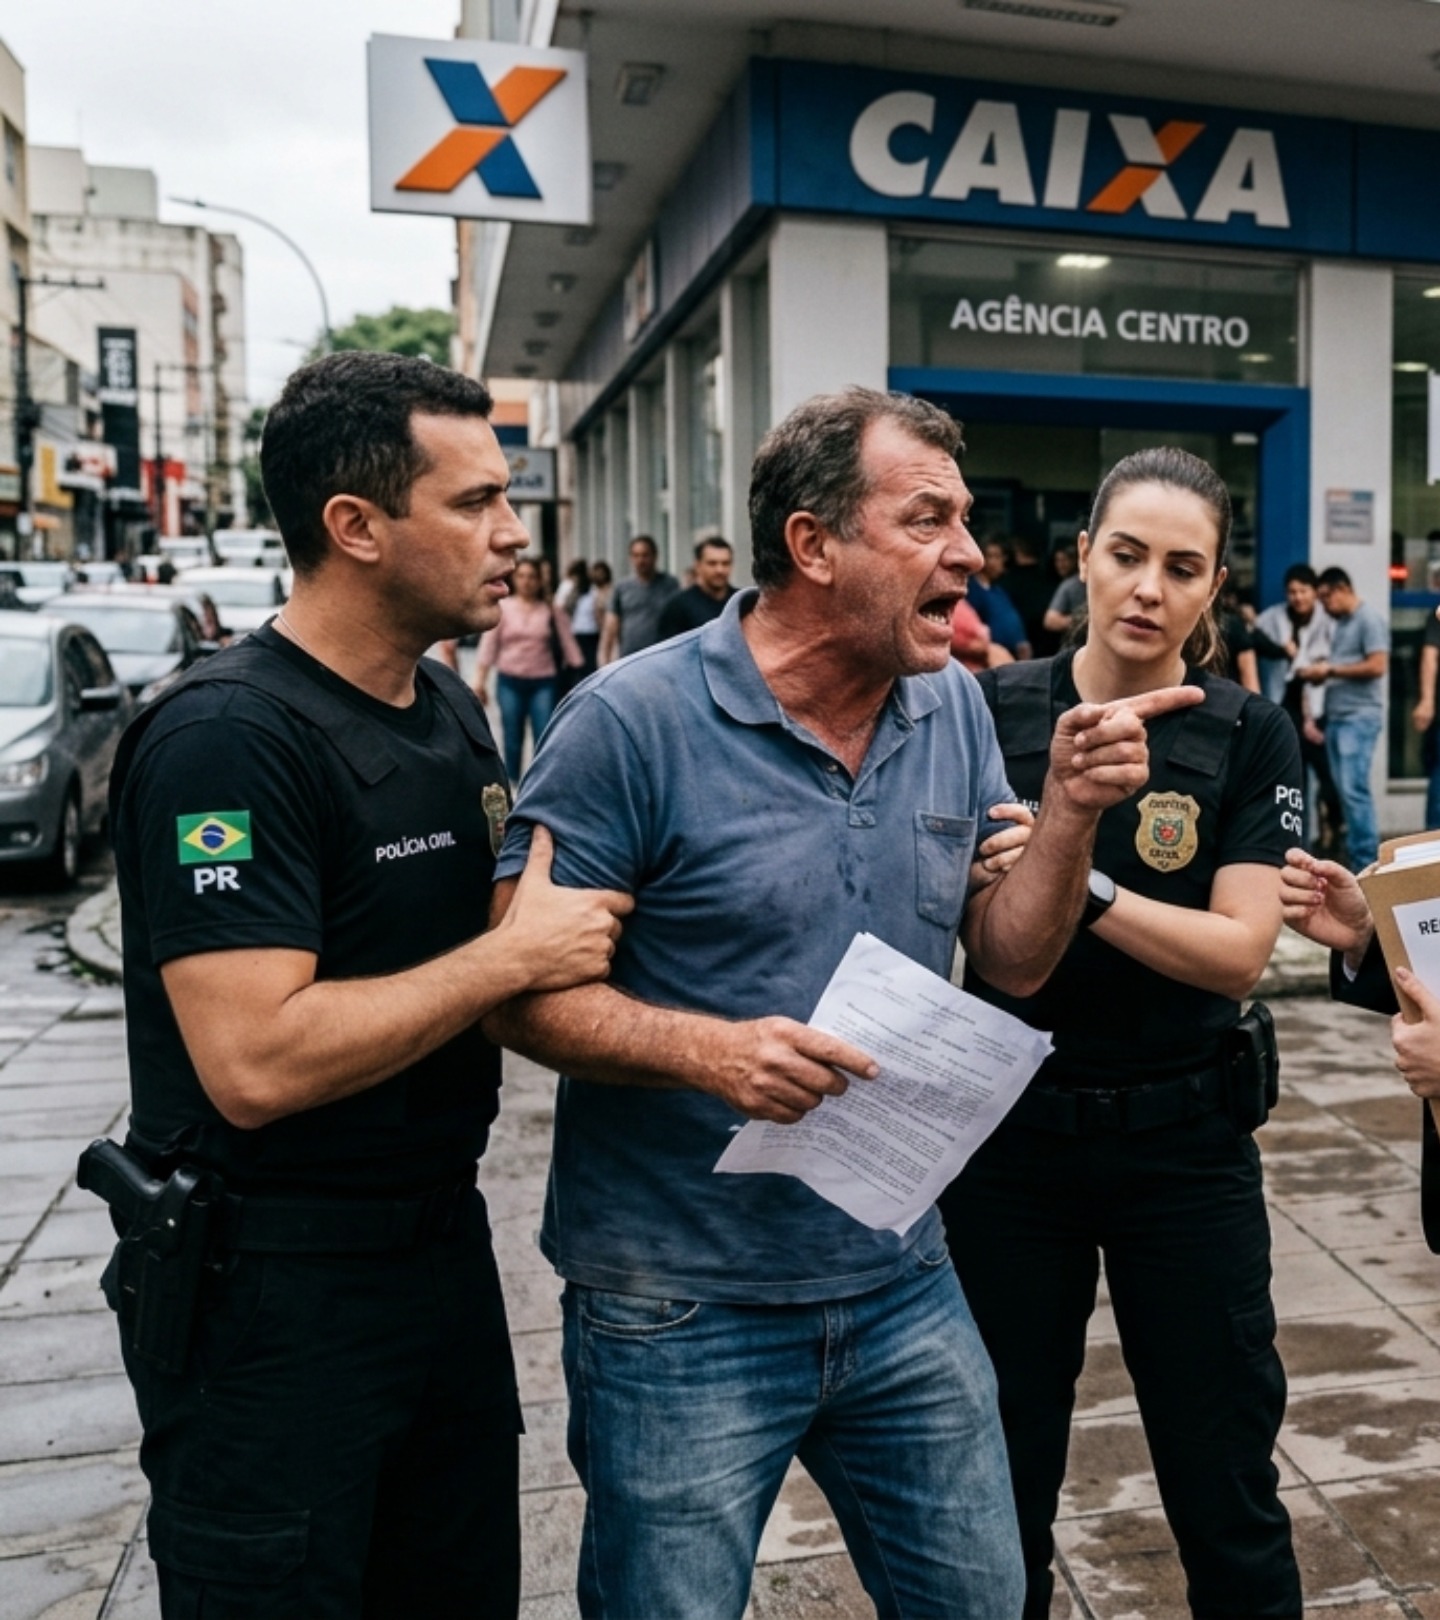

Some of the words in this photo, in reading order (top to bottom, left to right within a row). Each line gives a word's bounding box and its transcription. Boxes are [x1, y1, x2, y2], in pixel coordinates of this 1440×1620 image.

[849, 90, 1291, 228] CAIXA
[950, 294, 1107, 339] AGÊNCIA
[1116, 310, 1250, 348] CENTRO
[375, 835, 428, 863] POLÍCIA
[193, 864, 242, 895] PR
